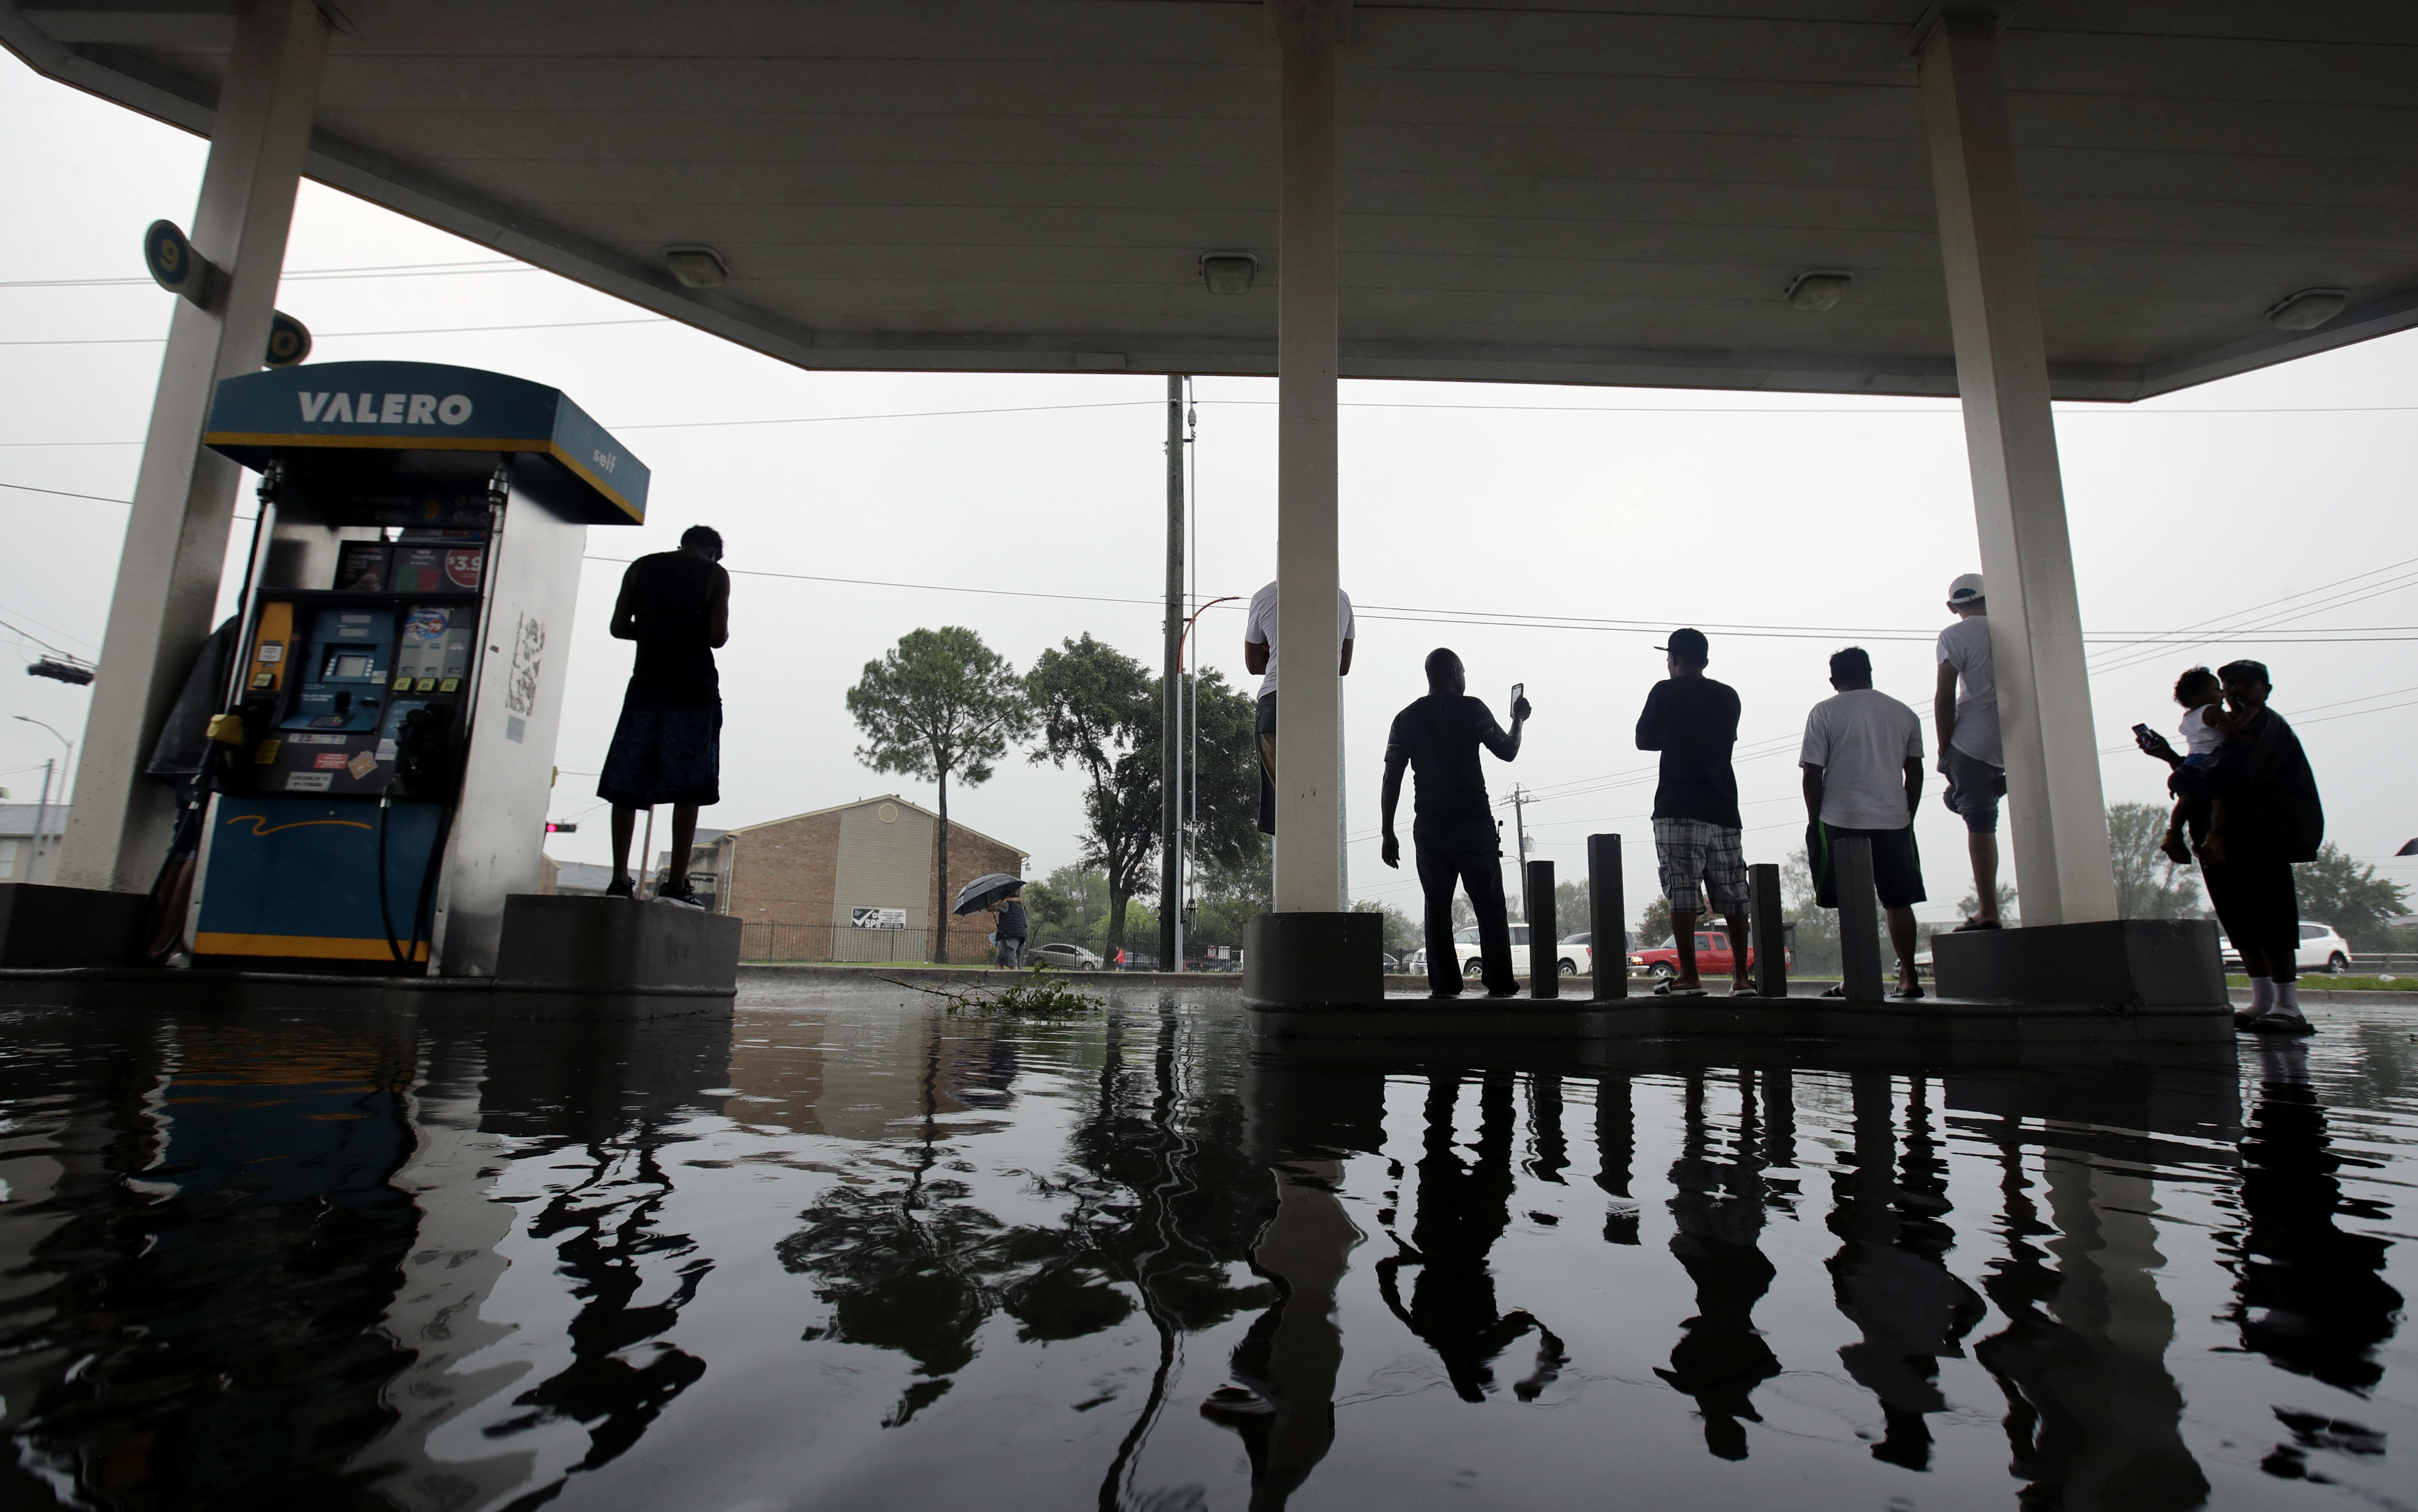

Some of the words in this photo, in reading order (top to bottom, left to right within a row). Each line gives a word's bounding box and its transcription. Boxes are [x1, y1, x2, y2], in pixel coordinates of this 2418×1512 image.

[159, 238, 179, 272] 9
[298, 391, 473, 425] VALERO
[593, 448, 617, 474] self
[425, 500, 440, 519] 9
